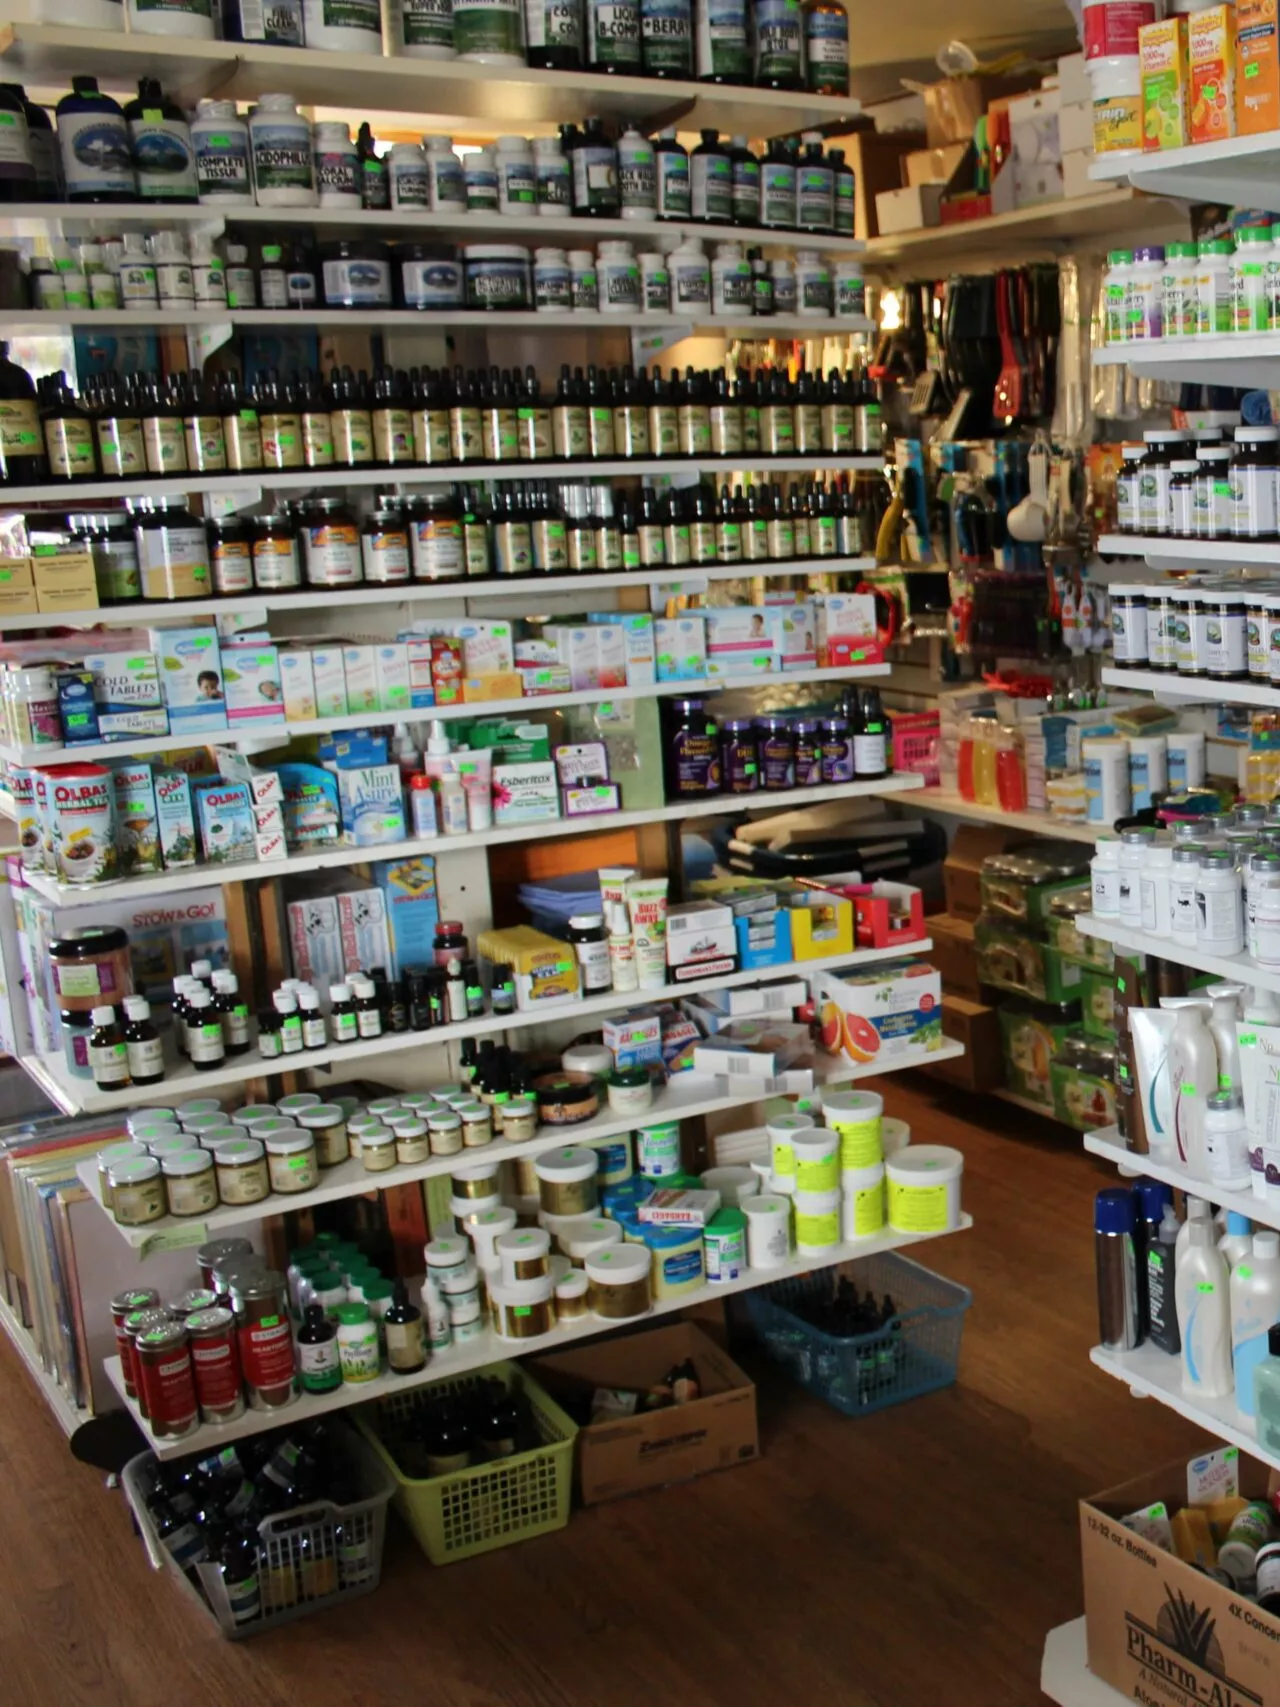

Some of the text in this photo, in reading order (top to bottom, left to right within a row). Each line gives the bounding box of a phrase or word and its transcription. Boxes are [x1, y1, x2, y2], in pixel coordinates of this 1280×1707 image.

[198, 157, 244, 169] COMPLETE
[204, 167, 237, 178] TISSUE
[110, 683, 156, 696] TABLETS
[11, 777, 33, 791] OLB
[360, 769, 395, 788] Mint
[55, 784, 108, 801] OLBAS
[206, 790, 246, 807] OLBAS
[132, 910, 174, 928] STOW
[187, 903, 216, 919] GO!
[1111, 1532, 1125, 1548] oz.
[1125, 1537, 1158, 1568] Bottles
[1228, 1602, 1242, 1621] 4X
[1126, 1625, 1244, 1707] Pharm-Alo
